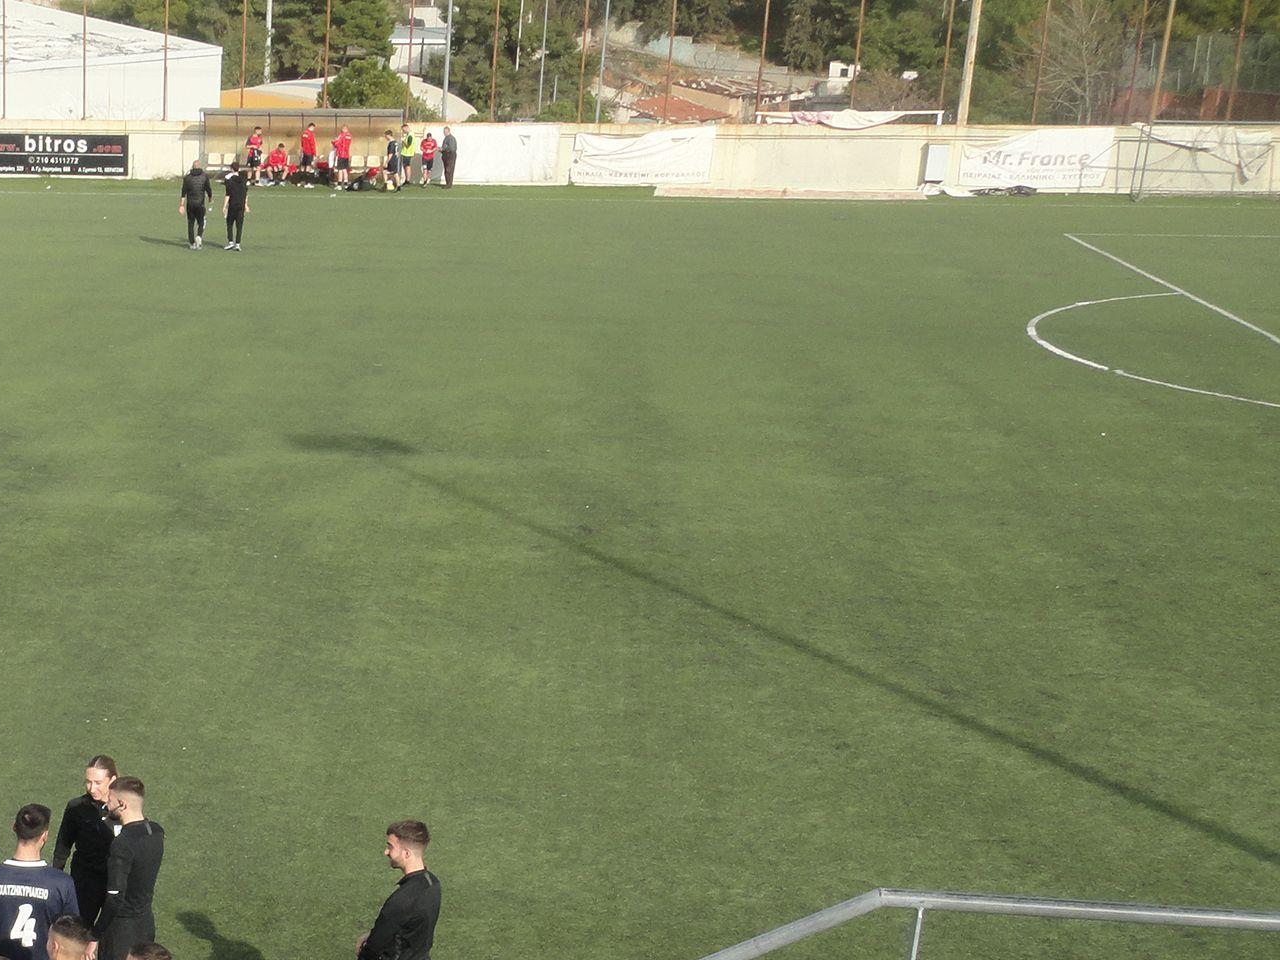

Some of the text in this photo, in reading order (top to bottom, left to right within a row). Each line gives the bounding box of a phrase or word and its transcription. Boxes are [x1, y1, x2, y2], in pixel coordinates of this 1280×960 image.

[24, 135, 88, 153] bitros
[1018, 151, 1091, 166] France
[0, 885, 49, 900] ΧΑΤΖΗΚΥΡΙΑΚΕΙΟ
[10, 903, 37, 948] 4
